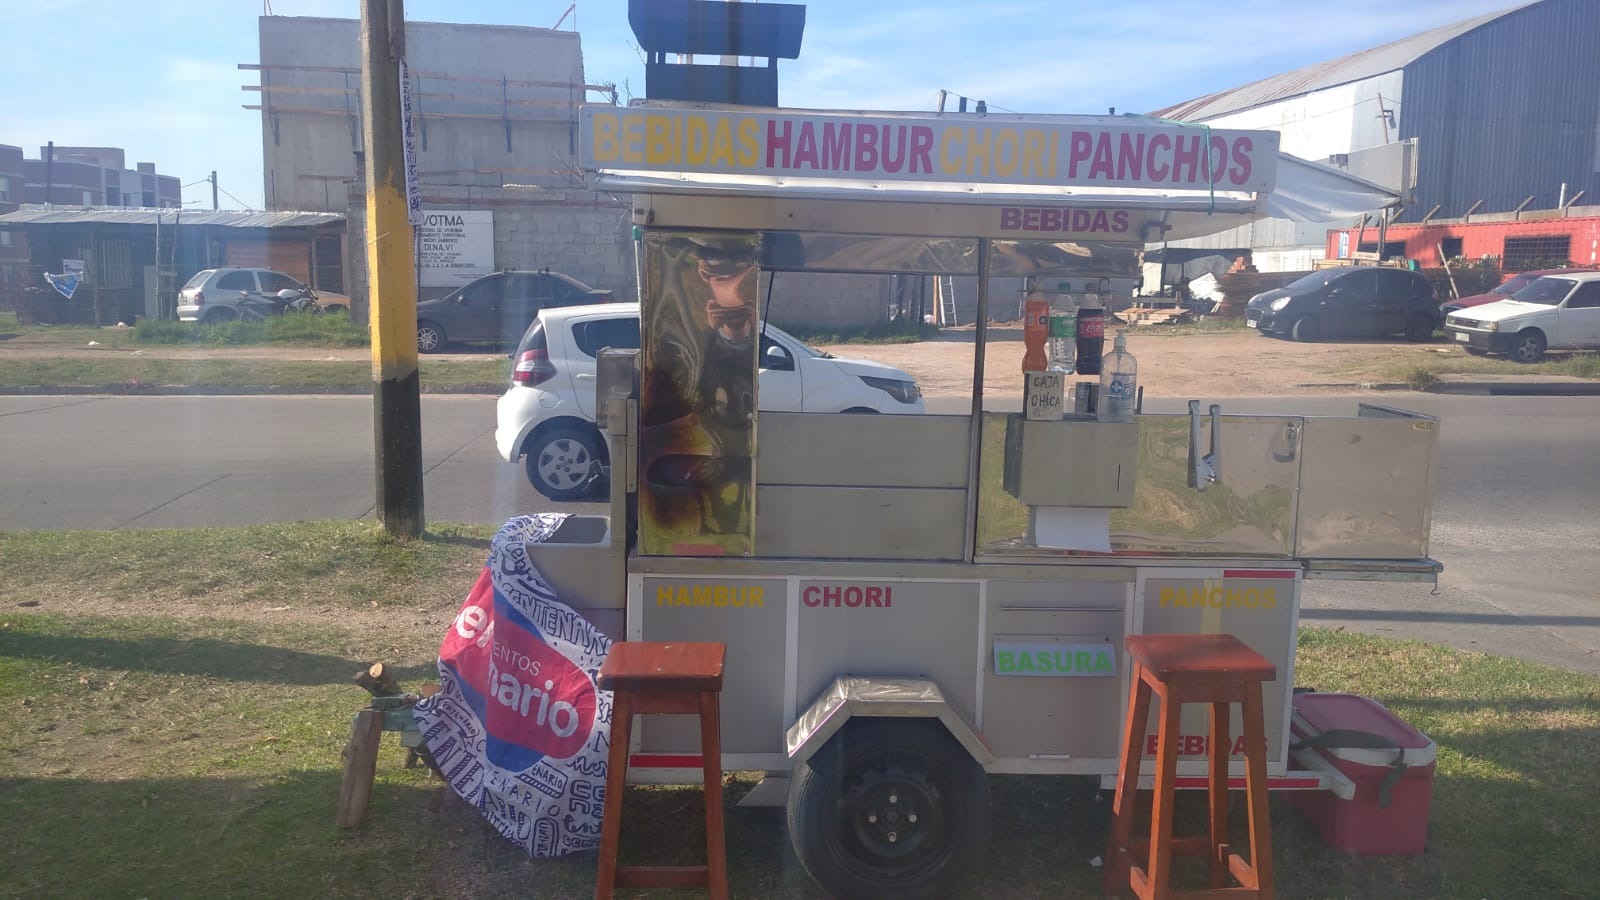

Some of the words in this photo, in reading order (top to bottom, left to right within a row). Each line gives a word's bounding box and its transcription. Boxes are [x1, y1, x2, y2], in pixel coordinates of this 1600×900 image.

[592, 113, 760, 167] BEBIDAS
[765, 119, 934, 174] HAMBUR
[939, 126, 1060, 178] CHORI
[1068, 131, 1253, 185] PANCHOS
[1000, 207, 1129, 233] BEBIDAS
[657, 584, 765, 608] HAMBUR
[802, 586, 892, 608] CHORI
[1158, 587, 1277, 609] PANCHOS
[998, 650, 1114, 673] BASURA
